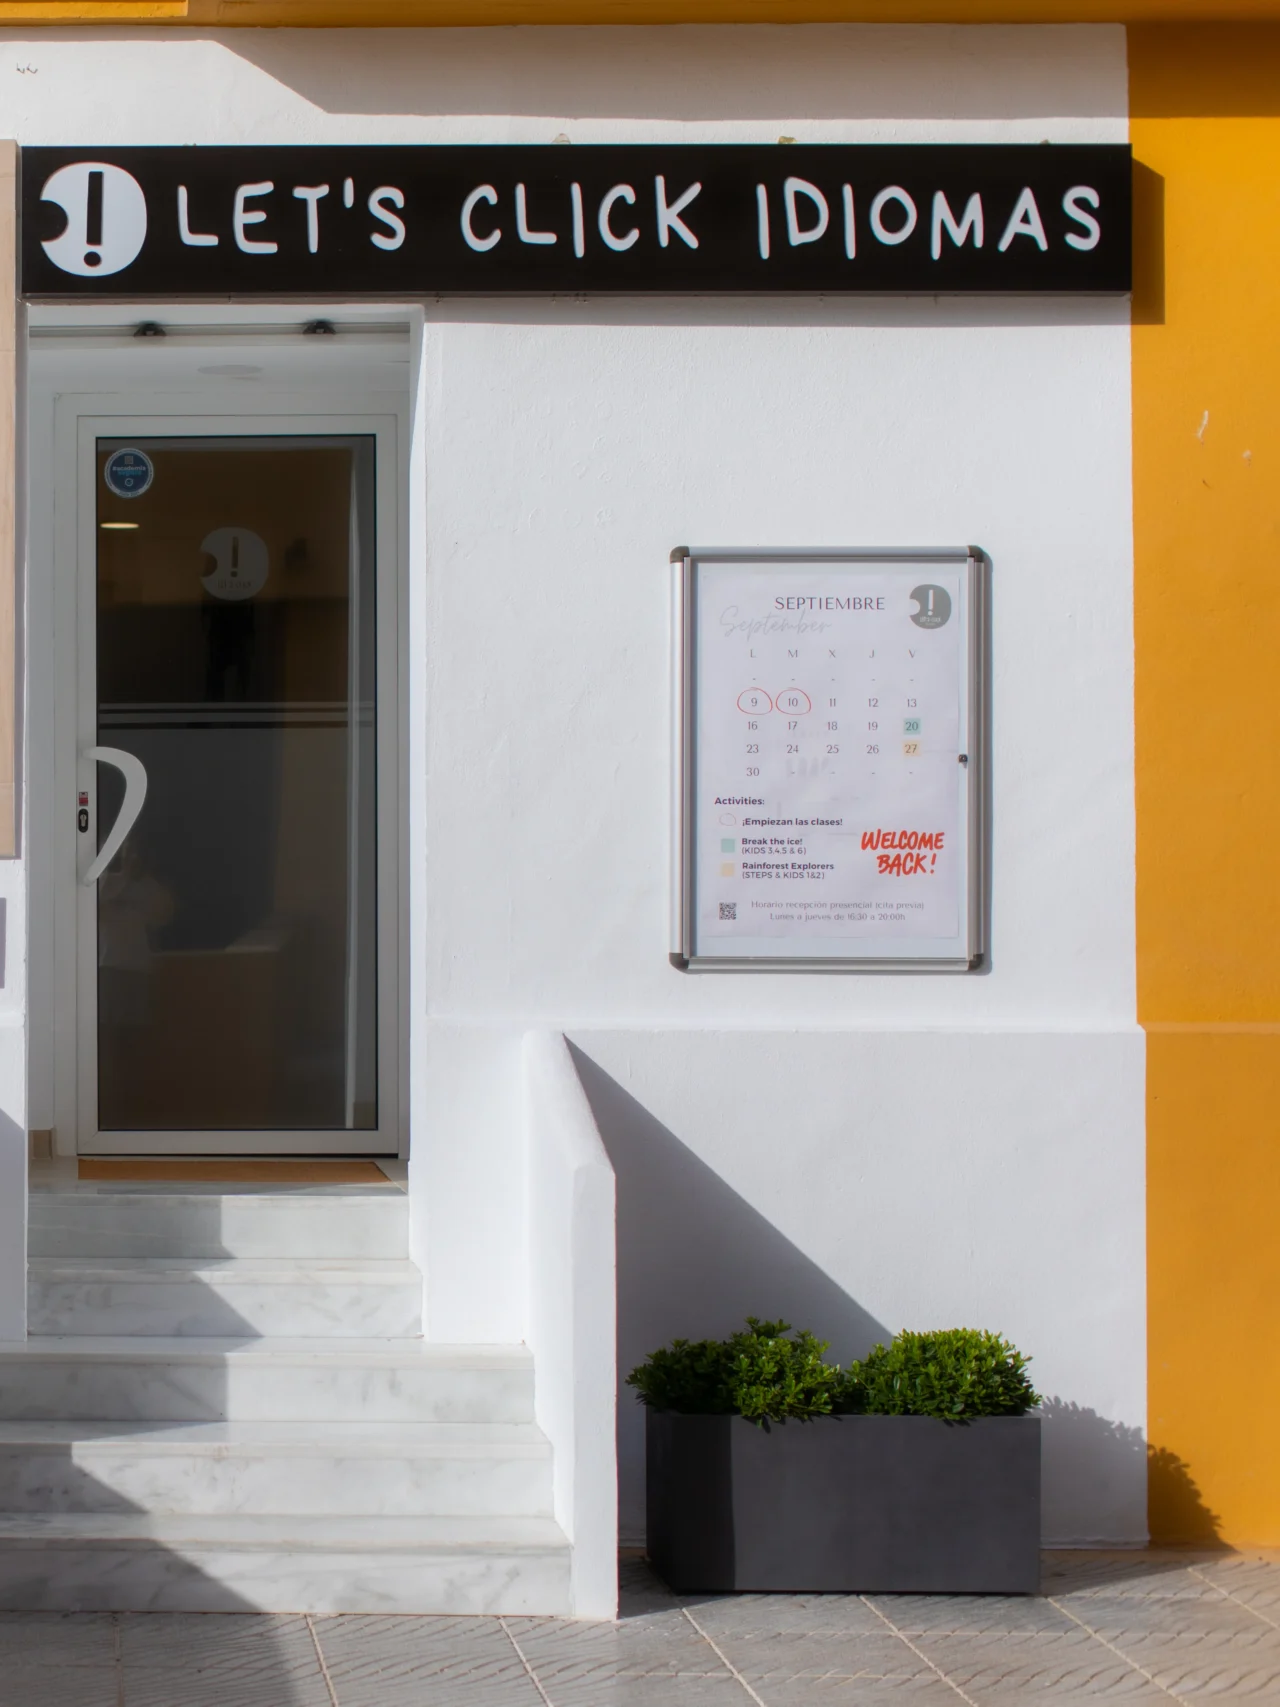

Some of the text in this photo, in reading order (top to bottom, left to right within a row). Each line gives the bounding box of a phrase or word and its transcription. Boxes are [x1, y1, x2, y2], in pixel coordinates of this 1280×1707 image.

[177, 174, 1101, 260] LET'S CLICK IDIOMAS
[774, 596, 886, 610] SEPTIEMBRE
[720, 605, 832, 640] September
[749, 649, 916, 658] L M X J V
[750, 698, 918, 707] 9 10 11 12 13
[747, 721, 919, 731] 16 17 18 19 20
[746, 743, 918, 754] 23 24 25 26 27
[746, 767, 760, 776] 30
[714, 796, 765, 805] Activities:
[742, 817, 843, 827] ¡Empiezan las clases!
[741, 837, 803, 845] Break the ice!
[861, 828, 945, 851] WELCOME
[741, 846, 766, 855] (KIDS
[797, 846, 807, 855] 6)
[742, 862, 834, 871] Rainforest Explorers
[876, 852, 937, 877] BACK!
[742, 871, 773, 880] (STEPS
[783, 871, 804, 879] KIDS
[806, 871, 825, 880] 1&2)
[751, 901, 783, 909] Horario
[830, 901, 873, 911] presencial
[769, 913, 795, 921] Lunes
[804, 913, 832, 922] jueves
[833, 913, 845, 921] de
